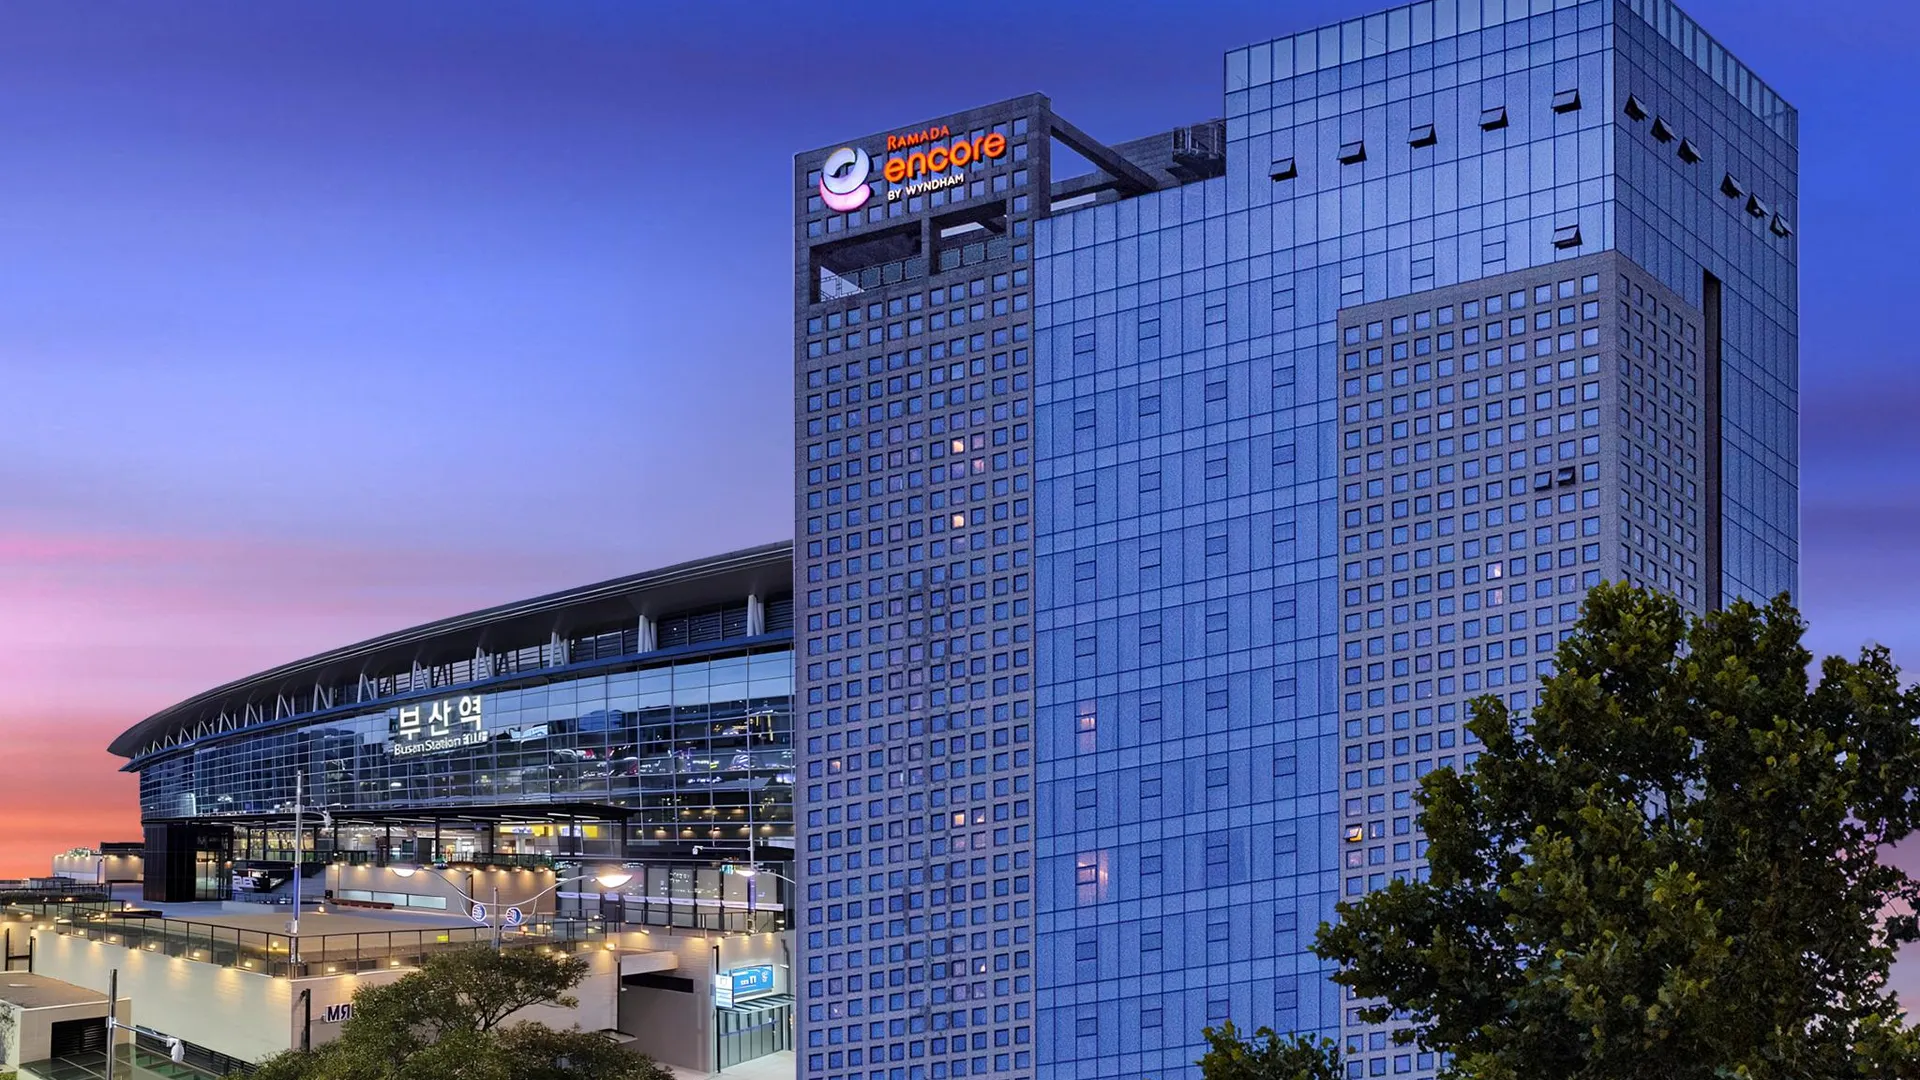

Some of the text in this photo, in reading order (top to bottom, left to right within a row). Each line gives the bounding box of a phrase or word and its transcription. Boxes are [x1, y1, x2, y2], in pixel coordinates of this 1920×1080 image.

[887, 125, 950, 151] RAMADA
[883, 133, 1006, 183] encore
[888, 173, 964, 201] BY WYNDHAM
[400, 695, 481, 740] 부산역
[394, 743, 424, 756] Busan
[425, 737, 461, 751] Station
